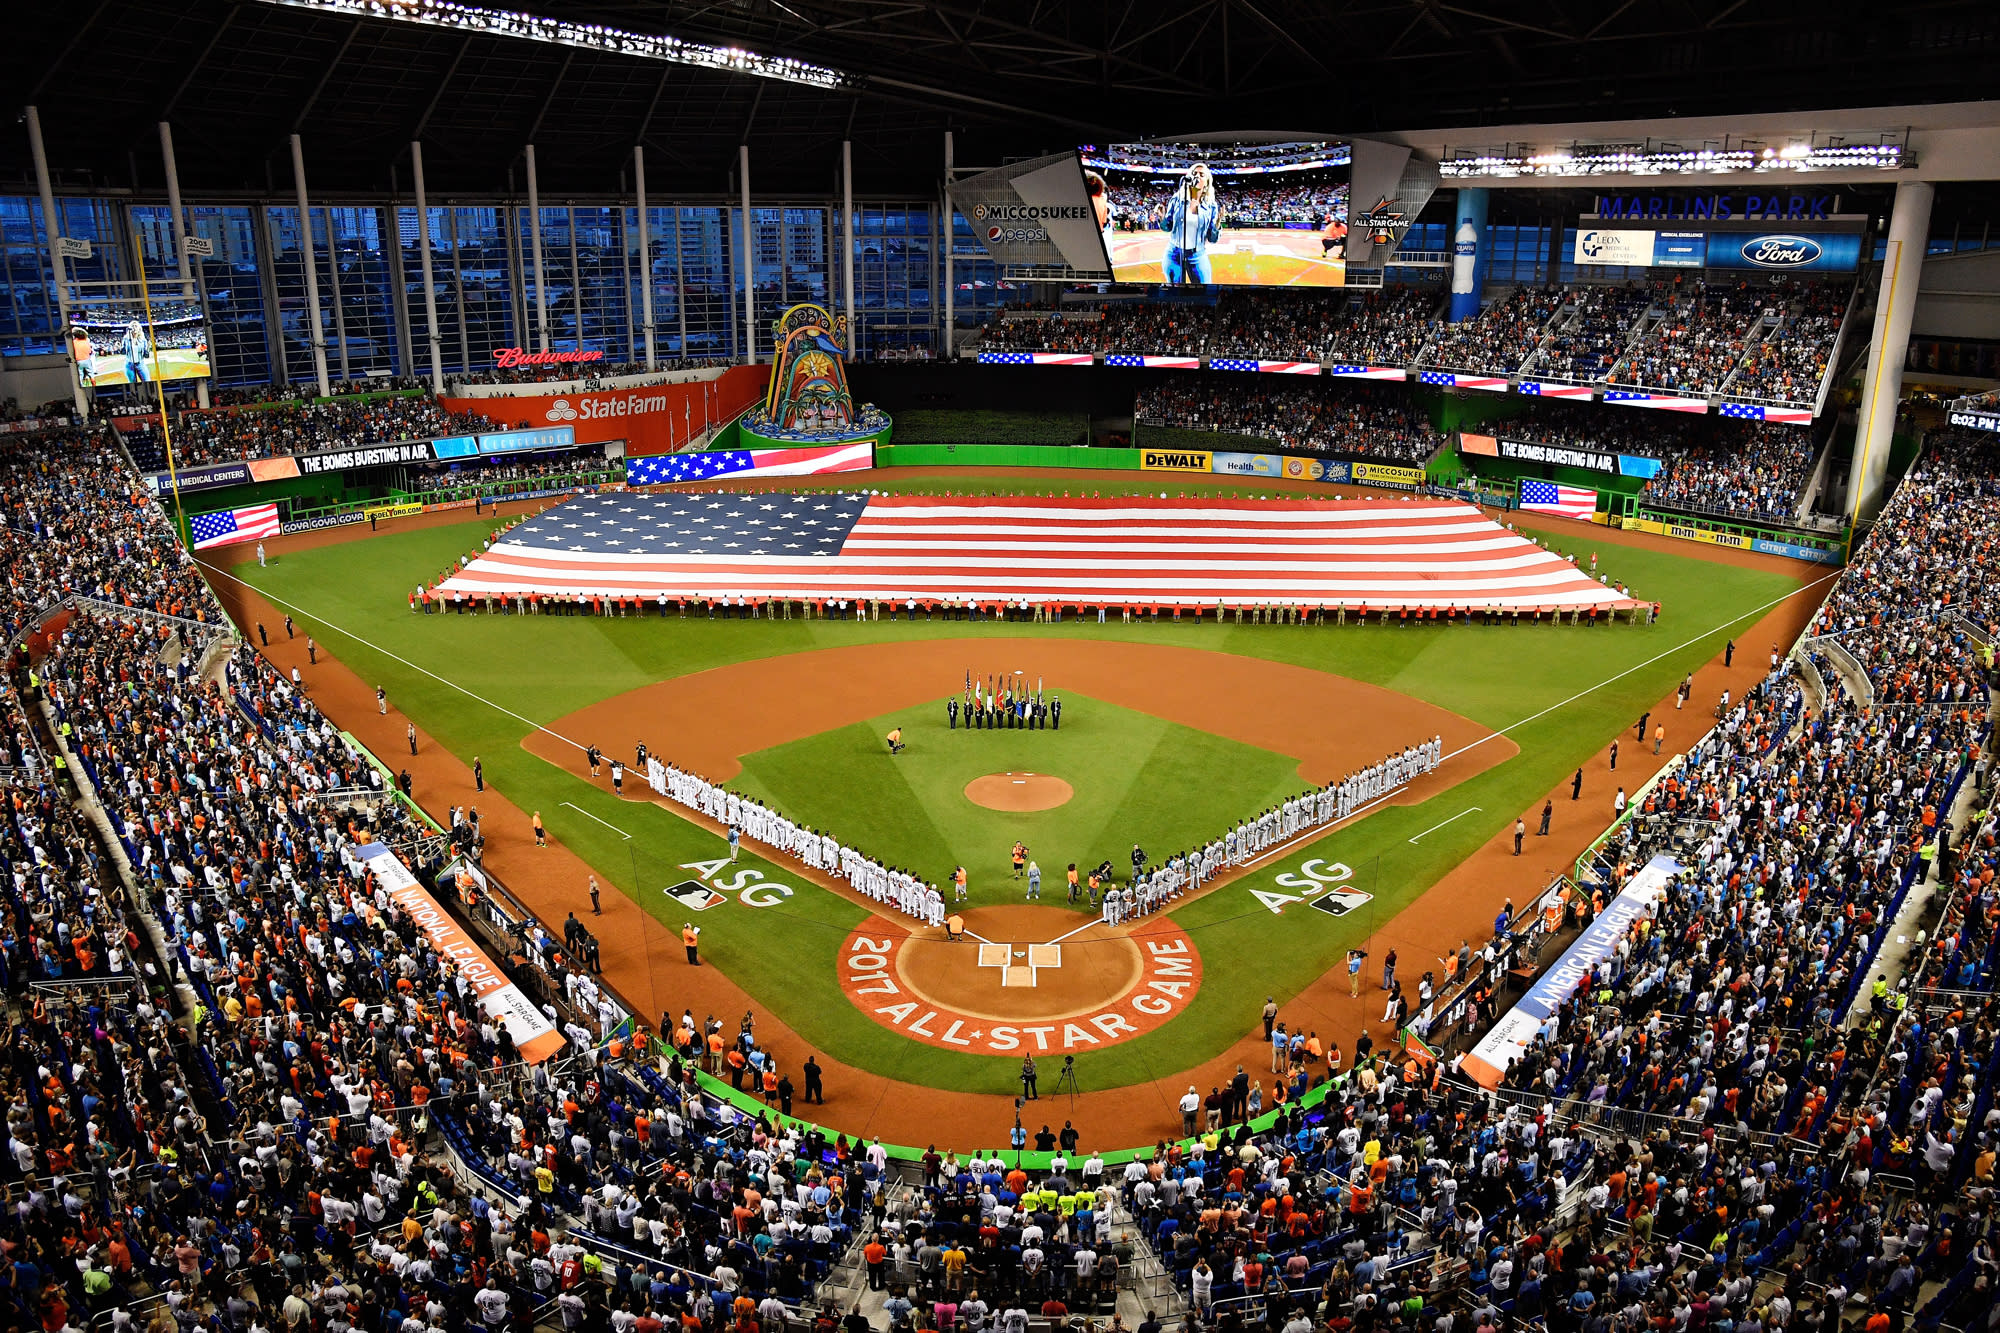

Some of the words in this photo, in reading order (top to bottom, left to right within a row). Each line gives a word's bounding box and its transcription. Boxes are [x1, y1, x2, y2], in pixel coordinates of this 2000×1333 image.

[989, 205, 1088, 219] MICCOSUKEE
[1599, 196, 1732, 220] MARLINS
[1745, 196, 1829, 220] PARK
[1354, 219, 1368, 227] ALL
[1369, 219, 1386, 227] STAR
[1387, 219, 1409, 227] GAME
[65, 239, 83, 248] 1997
[188, 238, 208, 247] 2003
[1004, 227, 1047, 243] pepsi
[1596, 236, 1621, 244] LEON
[1755, 239, 1807, 263] Ford
[1427, 272, 1443, 281] 465
[493, 347, 603, 368] Budweiser
[586, 380, 599, 389] 427
[1951, 413, 1976, 427] 8:02
[1978, 417, 1996, 430] PM
[483, 433, 569, 451] CLEVELANDER
[302, 457, 322, 473] THE
[322, 454, 353, 471] BOMBS
[354, 447, 400, 467] BURSTING
[400, 446, 411, 461] IN
[411, 444, 430, 460] AIR,
[1502, 442, 1517, 456] THE
[1517, 445, 1545, 461] BOMBS
[1545, 449, 1586, 467] BURSTING
[1586, 454, 1596, 468] IN
[1596, 454, 1613, 472] AIR,
[160, 479, 180, 489] LEON
[181, 475, 212, 487] MEDICAL
[213, 470, 245, 481] CENTERS
[1369, 467, 1422, 479] MICCOSUKEE
[557, 488, 572, 496] GAME
[311, 517, 337, 529] GOYA
[339, 512, 364, 524] GOYA
[283, 521, 310, 534] GOYA
[677, 858, 794, 908] ASG
[1248, 858, 1355, 915] ASG
[399, 888, 455, 943] NATIONAL
[442, 940, 502, 991] LEAGUE
[1532, 935, 1604, 1010] AMERICAN
[1596, 902, 1641, 948] LEAGUE
[847, 936, 901, 995] 2017
[1131, 938, 1193, 1015] GAME
[522, 1013, 542, 1031] GAME
[874, 1001, 970, 1046] ALL
[988, 1012, 1138, 1050] STAR
[564, 1267, 572, 1278] 10
[968, 1312, 980, 1320] 00
